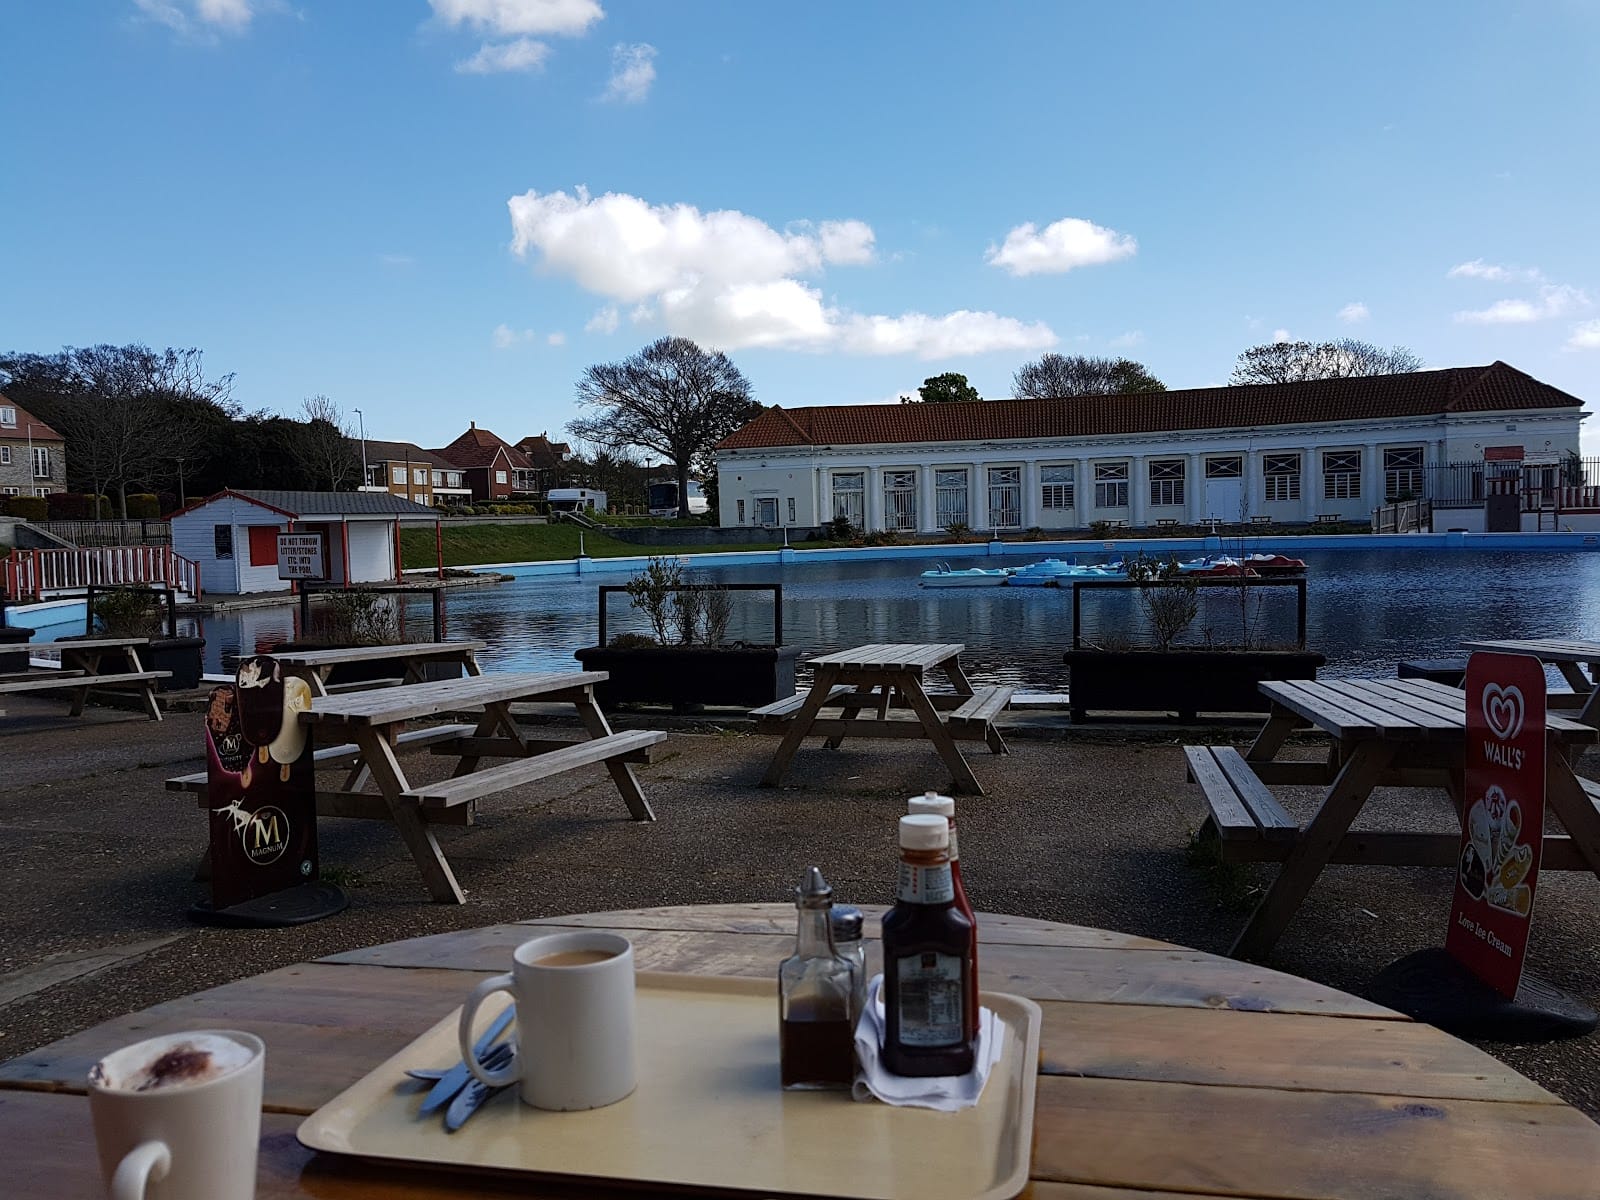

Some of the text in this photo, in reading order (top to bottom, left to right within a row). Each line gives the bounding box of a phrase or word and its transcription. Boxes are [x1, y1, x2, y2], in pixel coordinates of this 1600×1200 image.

[280, 538, 317, 546] DO NOT THROW
[280, 547, 317, 555] LITTER/STONES
[299, 556, 311, 565] INTO
[288, 566, 298, 574] THE
[1483, 740, 1523, 771] WALL'S
[251, 841, 284, 858] MAGNUM
[1457, 911, 1513, 958] Love Ice Cream
